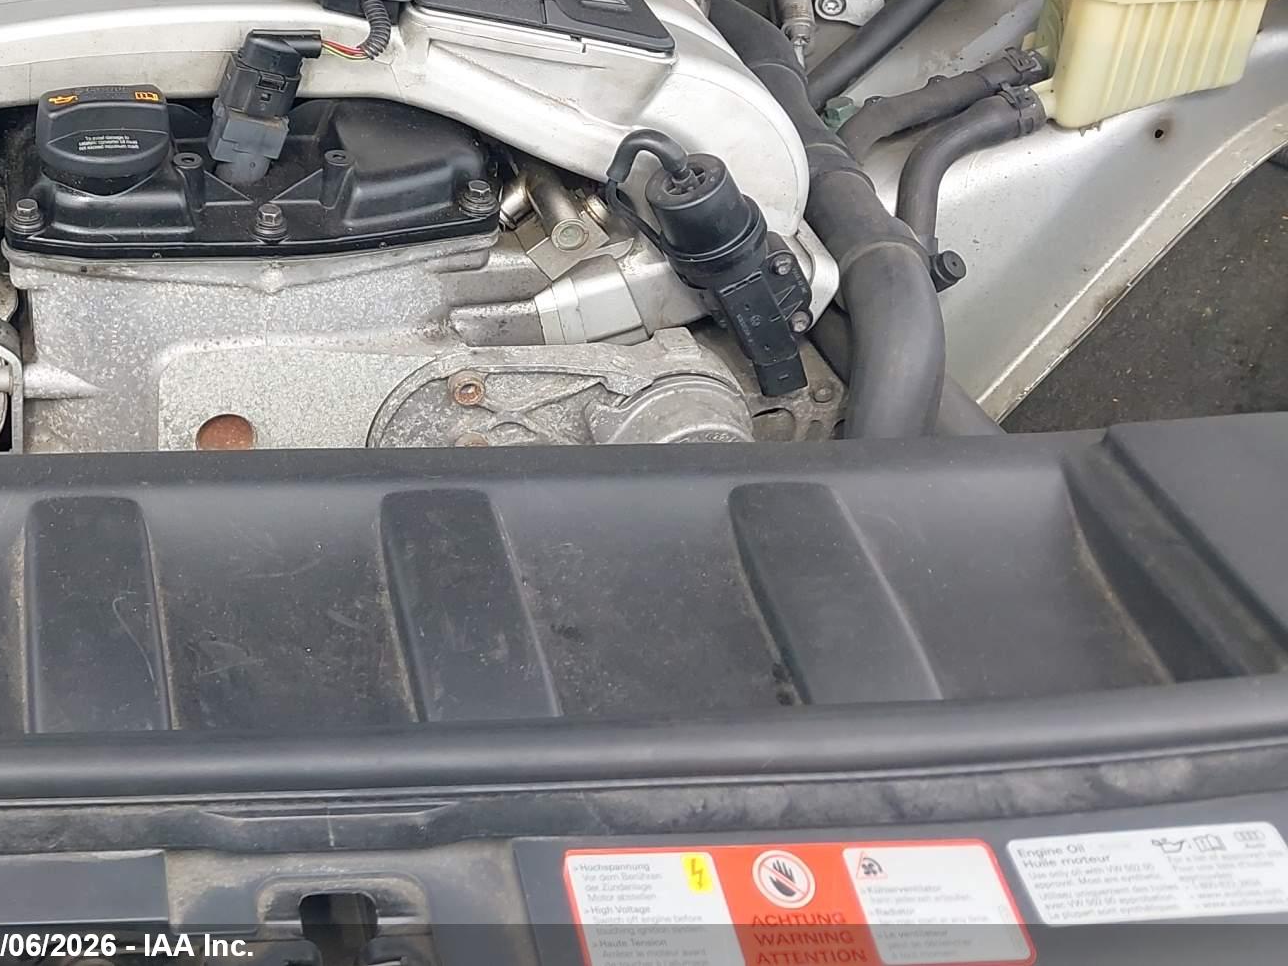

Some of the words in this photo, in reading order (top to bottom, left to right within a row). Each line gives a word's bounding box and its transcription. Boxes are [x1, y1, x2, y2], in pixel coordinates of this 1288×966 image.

[1017, 846, 1062, 858] Engine
[1067, 844, 1085, 854] Oil
[1023, 859, 1057, 868] Huile
[1062, 855, 1111, 866] moteur
[591, 906, 613, 915] High
[615, 905, 651, 915] Voltage
[752, 913, 847, 927] ACHTUNG
[753, 930, 855, 946] WARNING
[757, 950, 868, 965] ATTENTION
